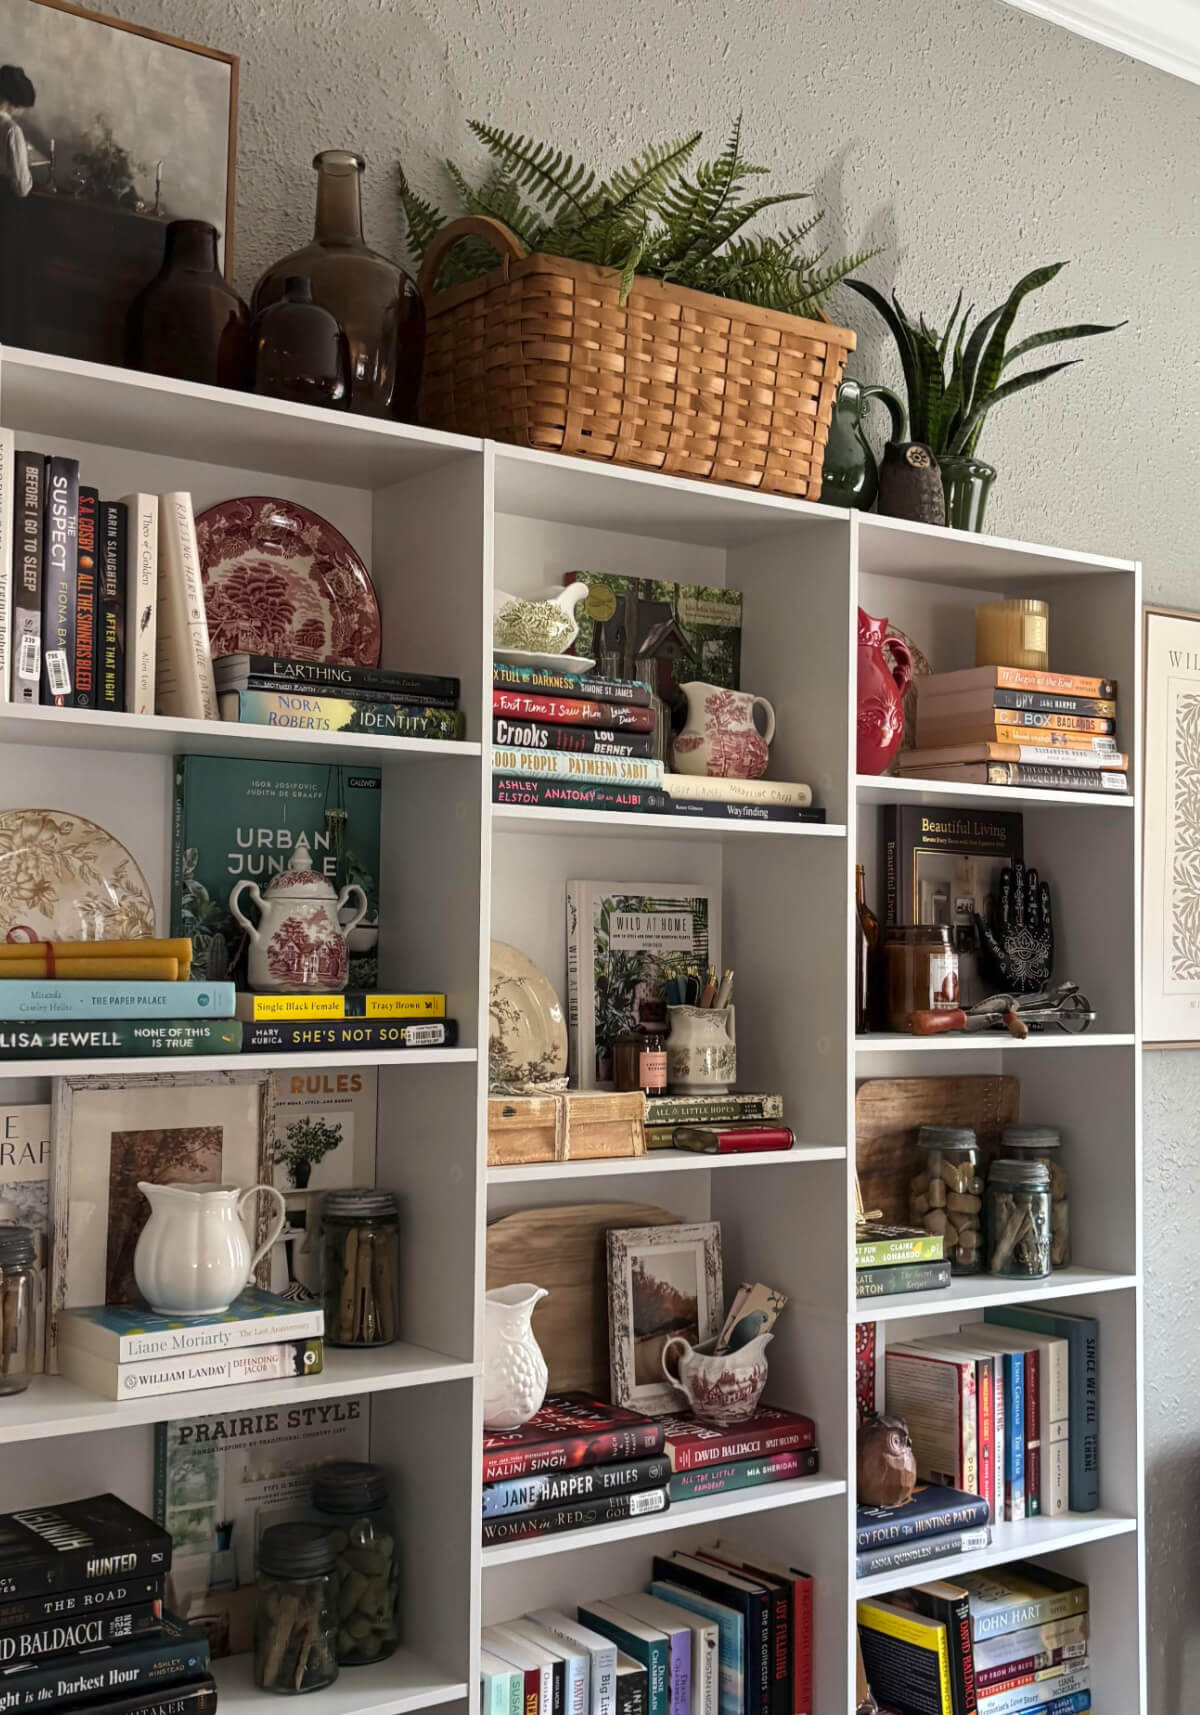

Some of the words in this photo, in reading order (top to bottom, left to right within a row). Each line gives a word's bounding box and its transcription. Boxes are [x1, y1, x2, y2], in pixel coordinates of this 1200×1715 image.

[25, 466, 39, 509] BEFORE
[24, 519, 38, 534] GO
[51, 475, 68, 573] SUSPECT
[67, 515, 76, 537] THE
[78, 517, 94, 553] COSBY
[107, 507, 117, 538] KARIN
[175, 503, 192, 560] RAISING
[24, 538, 37, 553] TO
[23, 556, 37, 592] SLEEP
[106, 540, 117, 596] SLAUGHTER
[77, 572, 94, 591] ALL
[183, 566, 199, 600] HARE
[57, 581, 68, 623] FIONA
[76, 593, 93, 612] THE
[75, 612, 93, 659] SINNERS
[105, 612, 116, 643] AFTER
[105, 647, 116, 670] THAT
[75, 660, 92, 692] BLEED
[273, 661, 352, 683] EARTHING
[500, 669, 521, 684] FULL
[532, 675, 575, 690] DARKNESS
[581, 684, 604, 695] SIMONE
[614, 686, 634, 699] JAMES
[104, 672, 116, 702] NIGHT
[278, 695, 321, 713] NORA
[360, 711, 429, 731] IDENTITY
[523, 699, 548, 714] Time
[1015, 695, 1034, 708] DRY
[1040, 700, 1053, 710] JANE
[1054, 700, 1077, 710] HARPER
[268, 712, 331, 730] ROBERTS
[497, 719, 549, 748] Crooks
[594, 730, 615, 742] LOU
[1024, 713, 1052, 727] BOX
[1056, 716, 1096, 730] BADLANDS
[593, 743, 634, 757] BERNEY
[520, 752, 558, 773] PEOPLE
[568, 757, 618, 778] PATMEENA
[498, 780, 538, 791] ASHLEY
[498, 792, 539, 803] ELSTON
[544, 789, 596, 802] ANATOMY
[616, 794, 641, 806] ALIBI
[727, 804, 769, 819] Wayfinding
[236, 827, 331, 850] URBAN
[921, 818, 971, 835] Beautiful
[974, 822, 1007, 841] Living
[227, 853, 337, 877] JUNE
[616, 917, 641, 931] WILD
[646, 917, 657, 931] AT
[661, 917, 687, 932] HOME
[568, 945, 577, 973] WILD
[92, 996, 108, 1006] THE
[109, 996, 136, 1005] PAPER
[137, 996, 167, 1005] PALACE
[257, 1002, 285, 1013] Single
[371, 1001, 394, 1012] Tracy
[568, 998, 578, 1027] HOME
[0, 1033, 43, 1048] LISA
[49, 1031, 122, 1047] JEWELL
[134, 1028, 166, 1037] NONE
[168, 1028, 184, 1037] OF
[184, 1027, 211, 1037] THIS
[152, 1039, 162, 1048] IS
[165, 1039, 194, 1048] TRUE
[251, 1036, 284, 1045] KUBICA
[255, 1028, 279, 1038] MARY
[292, 1030, 336, 1044] SHE'S
[341, 1028, 373, 1042] NOT
[290, 1074, 362, 1094] RULES
[128, 1339, 168, 1356] Liane
[172, 1331, 233, 1351] Moriarty
[1086, 1337, 1096, 1373] SINCE
[139, 1370, 186, 1385] WILLIAM
[188, 1364, 227, 1379] LANDAY
[233, 1354, 279, 1369] DEFENDING
[1086, 1377, 1096, 1396] WE
[178, 1412, 279, 1446] PRAIRIE
[287, 1400, 361, 1429] STYLE
[1086, 1400, 1096, 1425] FELL
[694, 1447, 720, 1462] DAVID
[721, 1440, 761, 1459] BALDACCI
[486, 1461, 526, 1479] NALINI
[531, 1455, 567, 1471] SINGH
[747, 1468, 761, 1477] MIA
[763, 1460, 798, 1474] SHERIDAN
[503, 1486, 537, 1508] JANE
[541, 1476, 593, 1501] HARPER
[603, 1469, 638, 1488] EXILES
[484, 1519, 538, 1540] WOMAN
[556, 1510, 584, 1526] RED
[872, 1525, 900, 1543] FOLEY
[915, 1513, 952, 1533] HUNTING
[953, 1507, 977, 1524] PARTY
[86, 1553, 138, 1579] HUNTED
[870, 1557, 892, 1570] ANNA
[893, 1546, 932, 1566] QUINDLEN
[44, 1598, 76, 1614] THE
[84, 1588, 127, 1606] ROAD
[123, 1613, 133, 1635] MAN
[978, 1613, 1008, 1635] JOHN
[1011, 1604, 1041, 1625] HART
[19, 1620, 104, 1657] BALDACCI
[960, 1619, 971, 1654] DAVID
[25, 1690, 35, 1705] is
[38, 1687, 54, 1703] the
[57, 1676, 105, 1697] Darkest
[109, 1668, 141, 1686] Hour
[600, 1672, 611, 1694] Big
[657, 1665, 666, 1692] DIANE
[962, 1655, 977, 1709] BALDACCI
[979, 1673, 988, 1682] UP
[989, 1668, 1007, 1679] FROM
